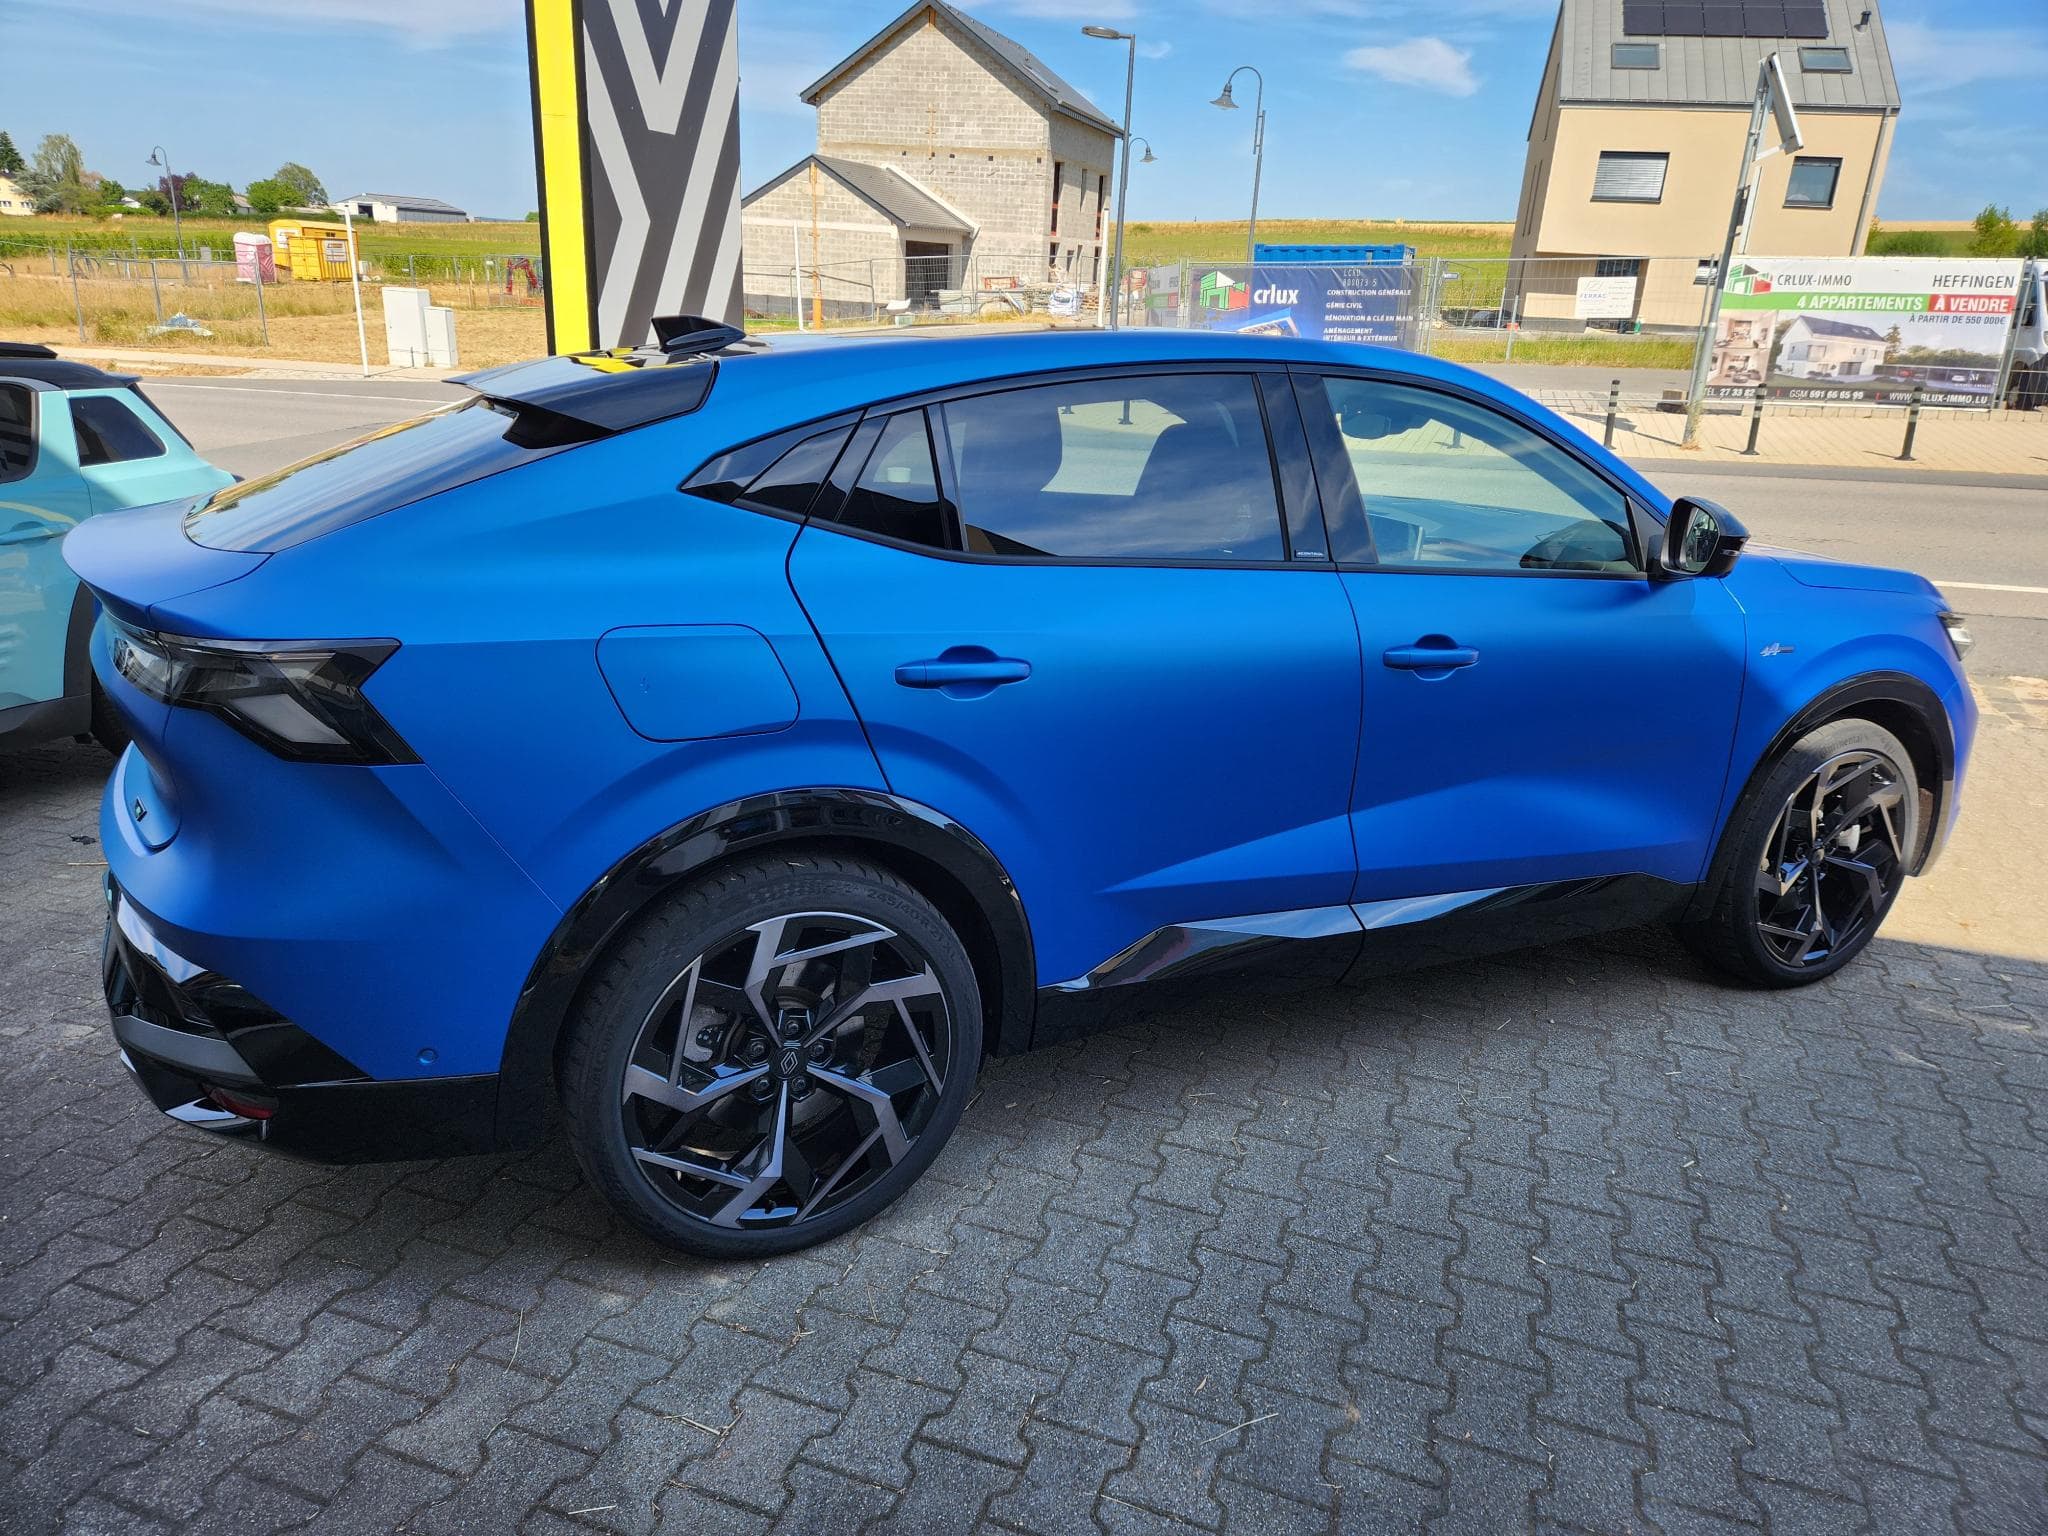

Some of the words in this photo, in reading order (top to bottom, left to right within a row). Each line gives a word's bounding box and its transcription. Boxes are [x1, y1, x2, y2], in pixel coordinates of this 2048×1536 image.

[1777, 274, 1852, 286] CRLUX-IMMO
[1932, 275, 2015, 288] HEFFINGEN
[1254, 283, 1299, 304] crlux
[1377, 288, 1412, 296] GÉNÉRALE
[1326, 301, 1345, 309] GÉNIE
[1797, 296, 1806, 308] 4
[1809, 296, 1924, 311] APPARTEMENTS
[1935, 295, 1946, 310] À
[1950, 297, 2009, 312] VENDRE
[1909, 313, 1916, 322] À
[1917, 315, 1949, 323] PARTIR
[1952, 316, 1963, 324] DE
[1965, 316, 1981, 325] 550
[1983, 316, 2006, 325] 000€
[1323, 326, 1373, 334] AMÉNAGEMENT
[1322, 334, 1358, 342] INTÉRIEUR
[1719, 388, 1731, 396] 27
[1731, 388, 1743, 396] 33
[1789, 389, 1809, 398] GSM
[1889, 392, 1988, 404] WWW.RLUX-IMMO.LU
